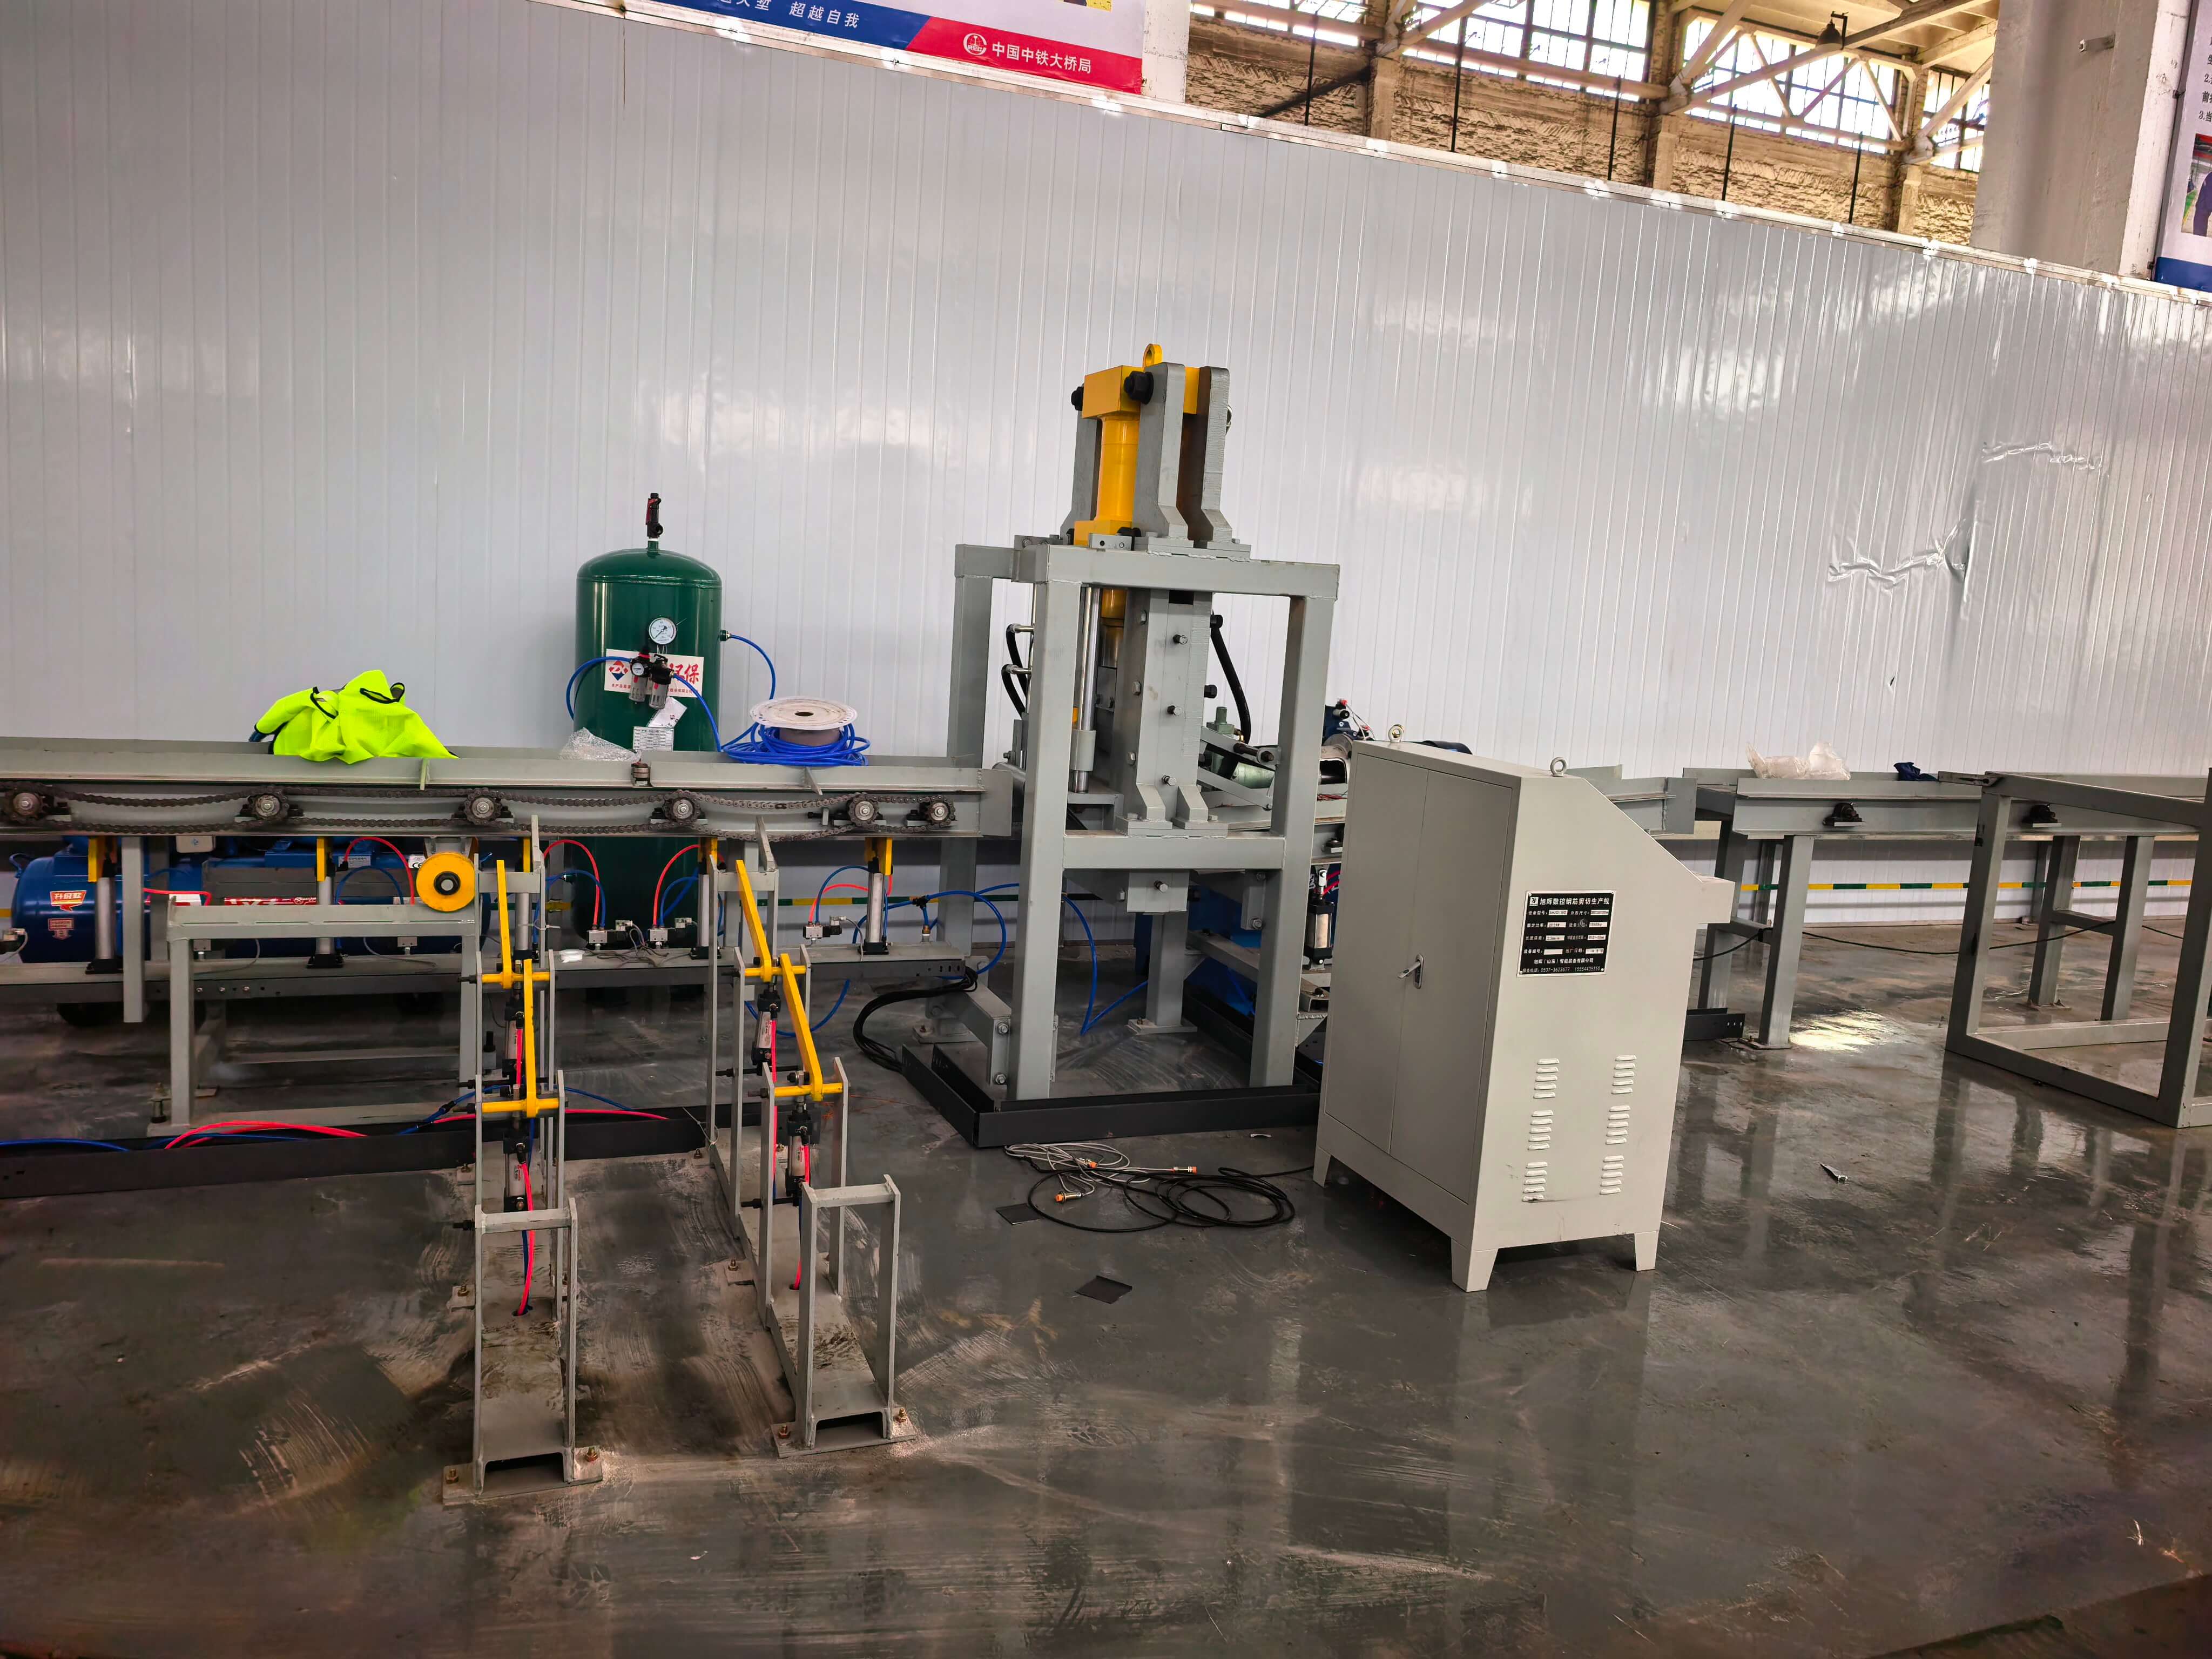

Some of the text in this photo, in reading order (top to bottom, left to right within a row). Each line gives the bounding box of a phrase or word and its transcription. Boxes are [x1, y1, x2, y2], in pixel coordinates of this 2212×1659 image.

[789, 1, 860, 28] 超越自我
[992, 42, 1091, 74] 中国中铁大桥局
[1539, 898, 1610, 906] 旭辉数控钢筋剪切生产线
